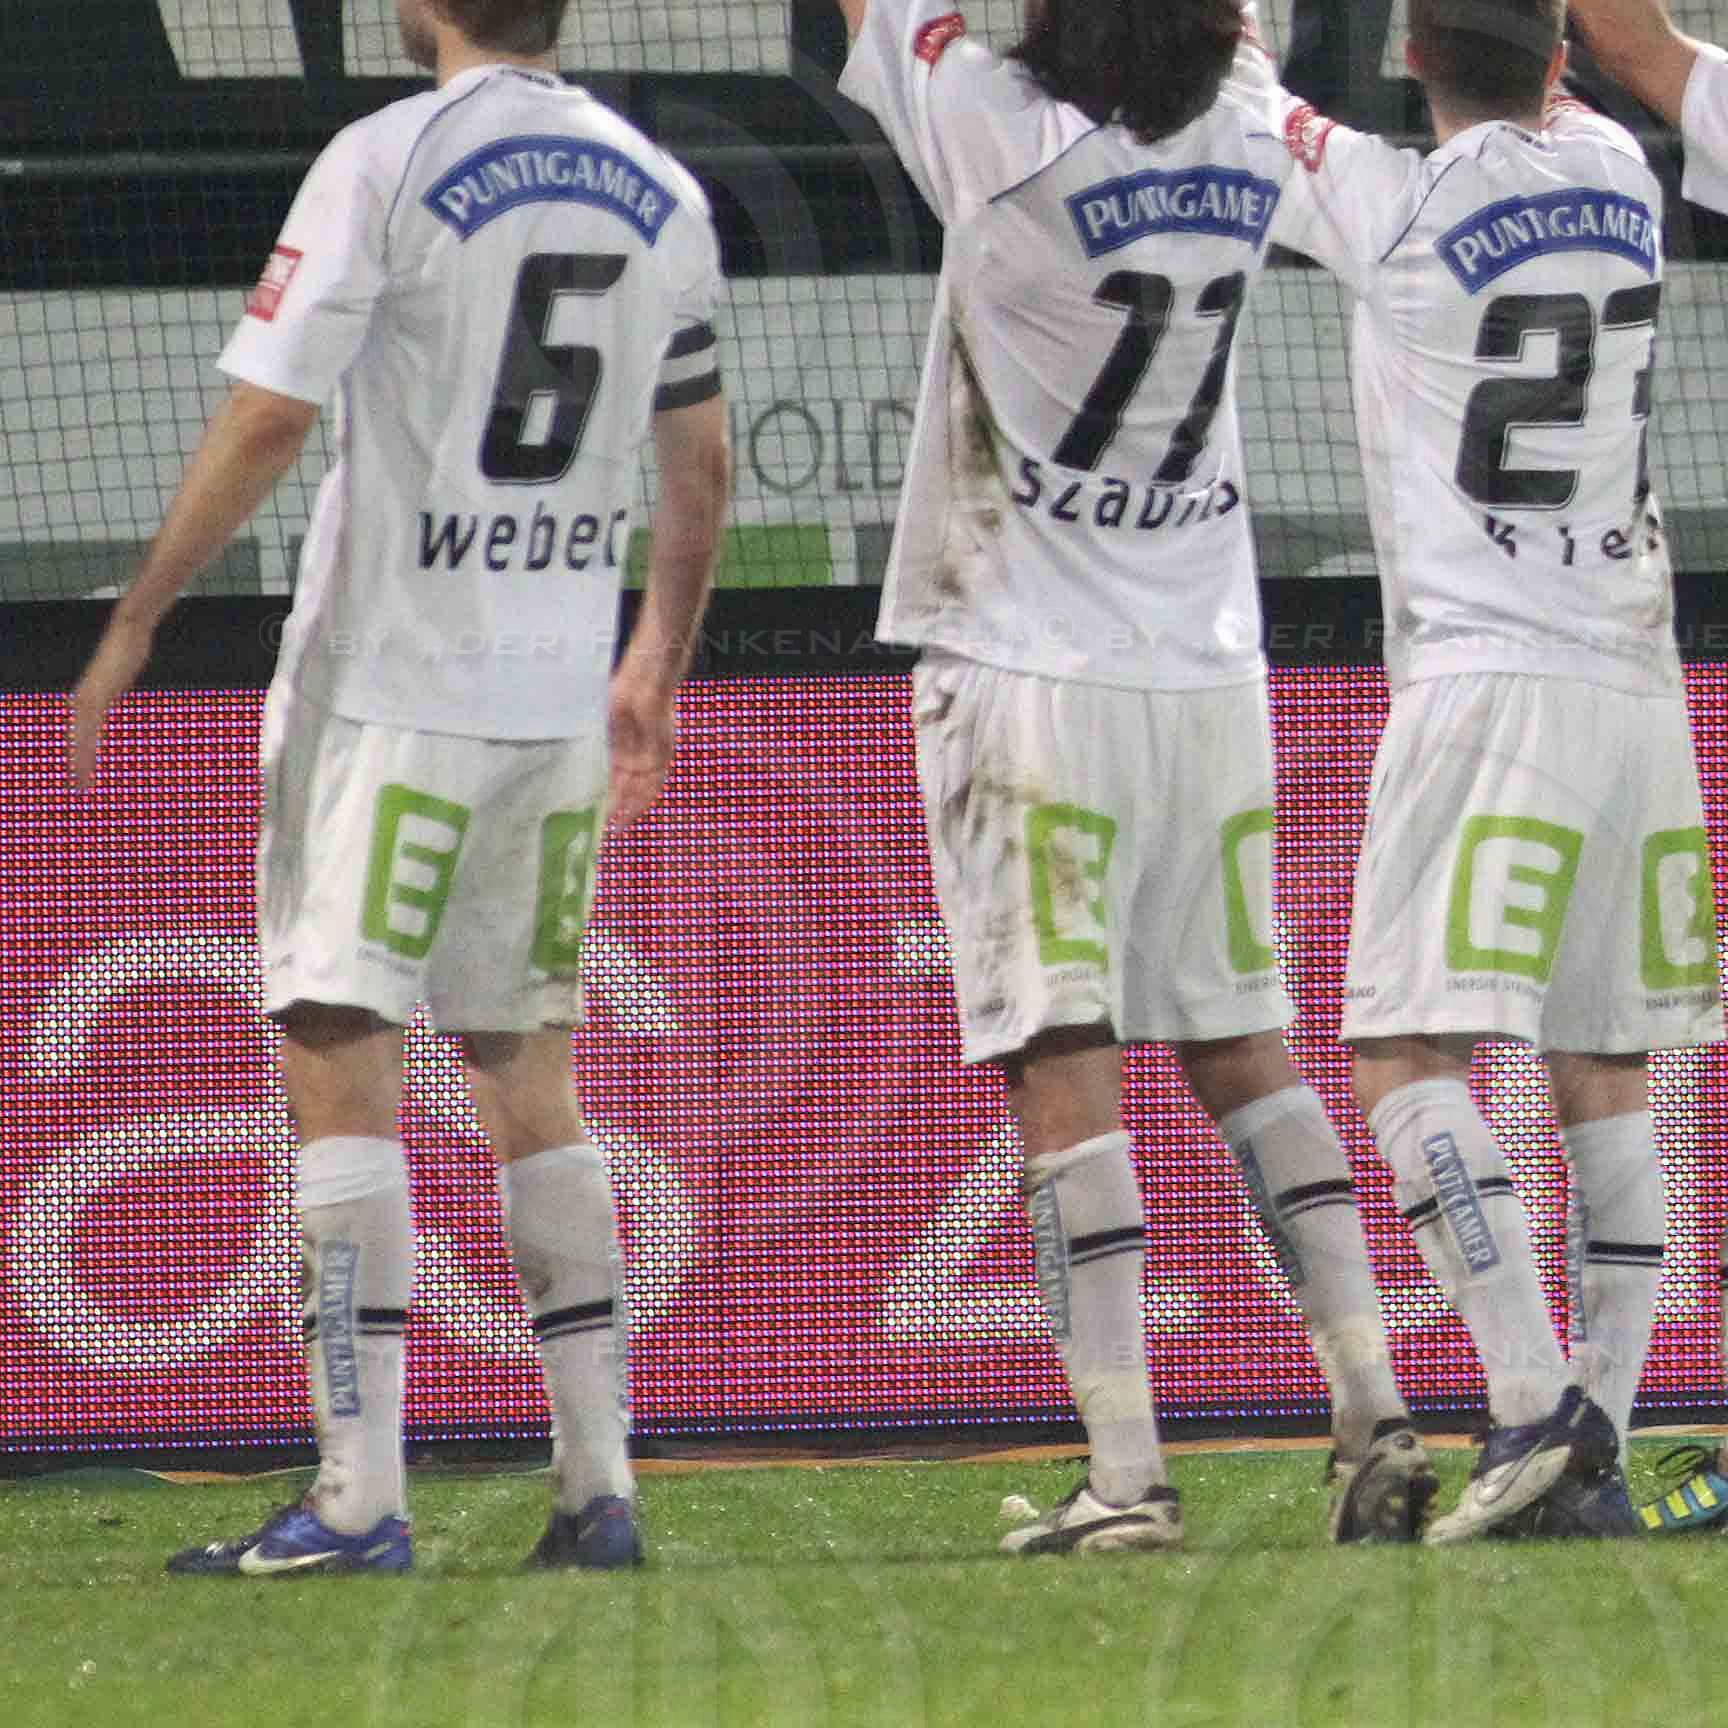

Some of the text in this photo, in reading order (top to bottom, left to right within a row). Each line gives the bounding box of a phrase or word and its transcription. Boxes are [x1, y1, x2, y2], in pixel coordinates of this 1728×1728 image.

[439, 148, 662, 226] PUNTIGAMER
[479, 252, 629, 485] 6
[728, 398, 915, 494] OLD
[417, 500, 627, 572] weber
